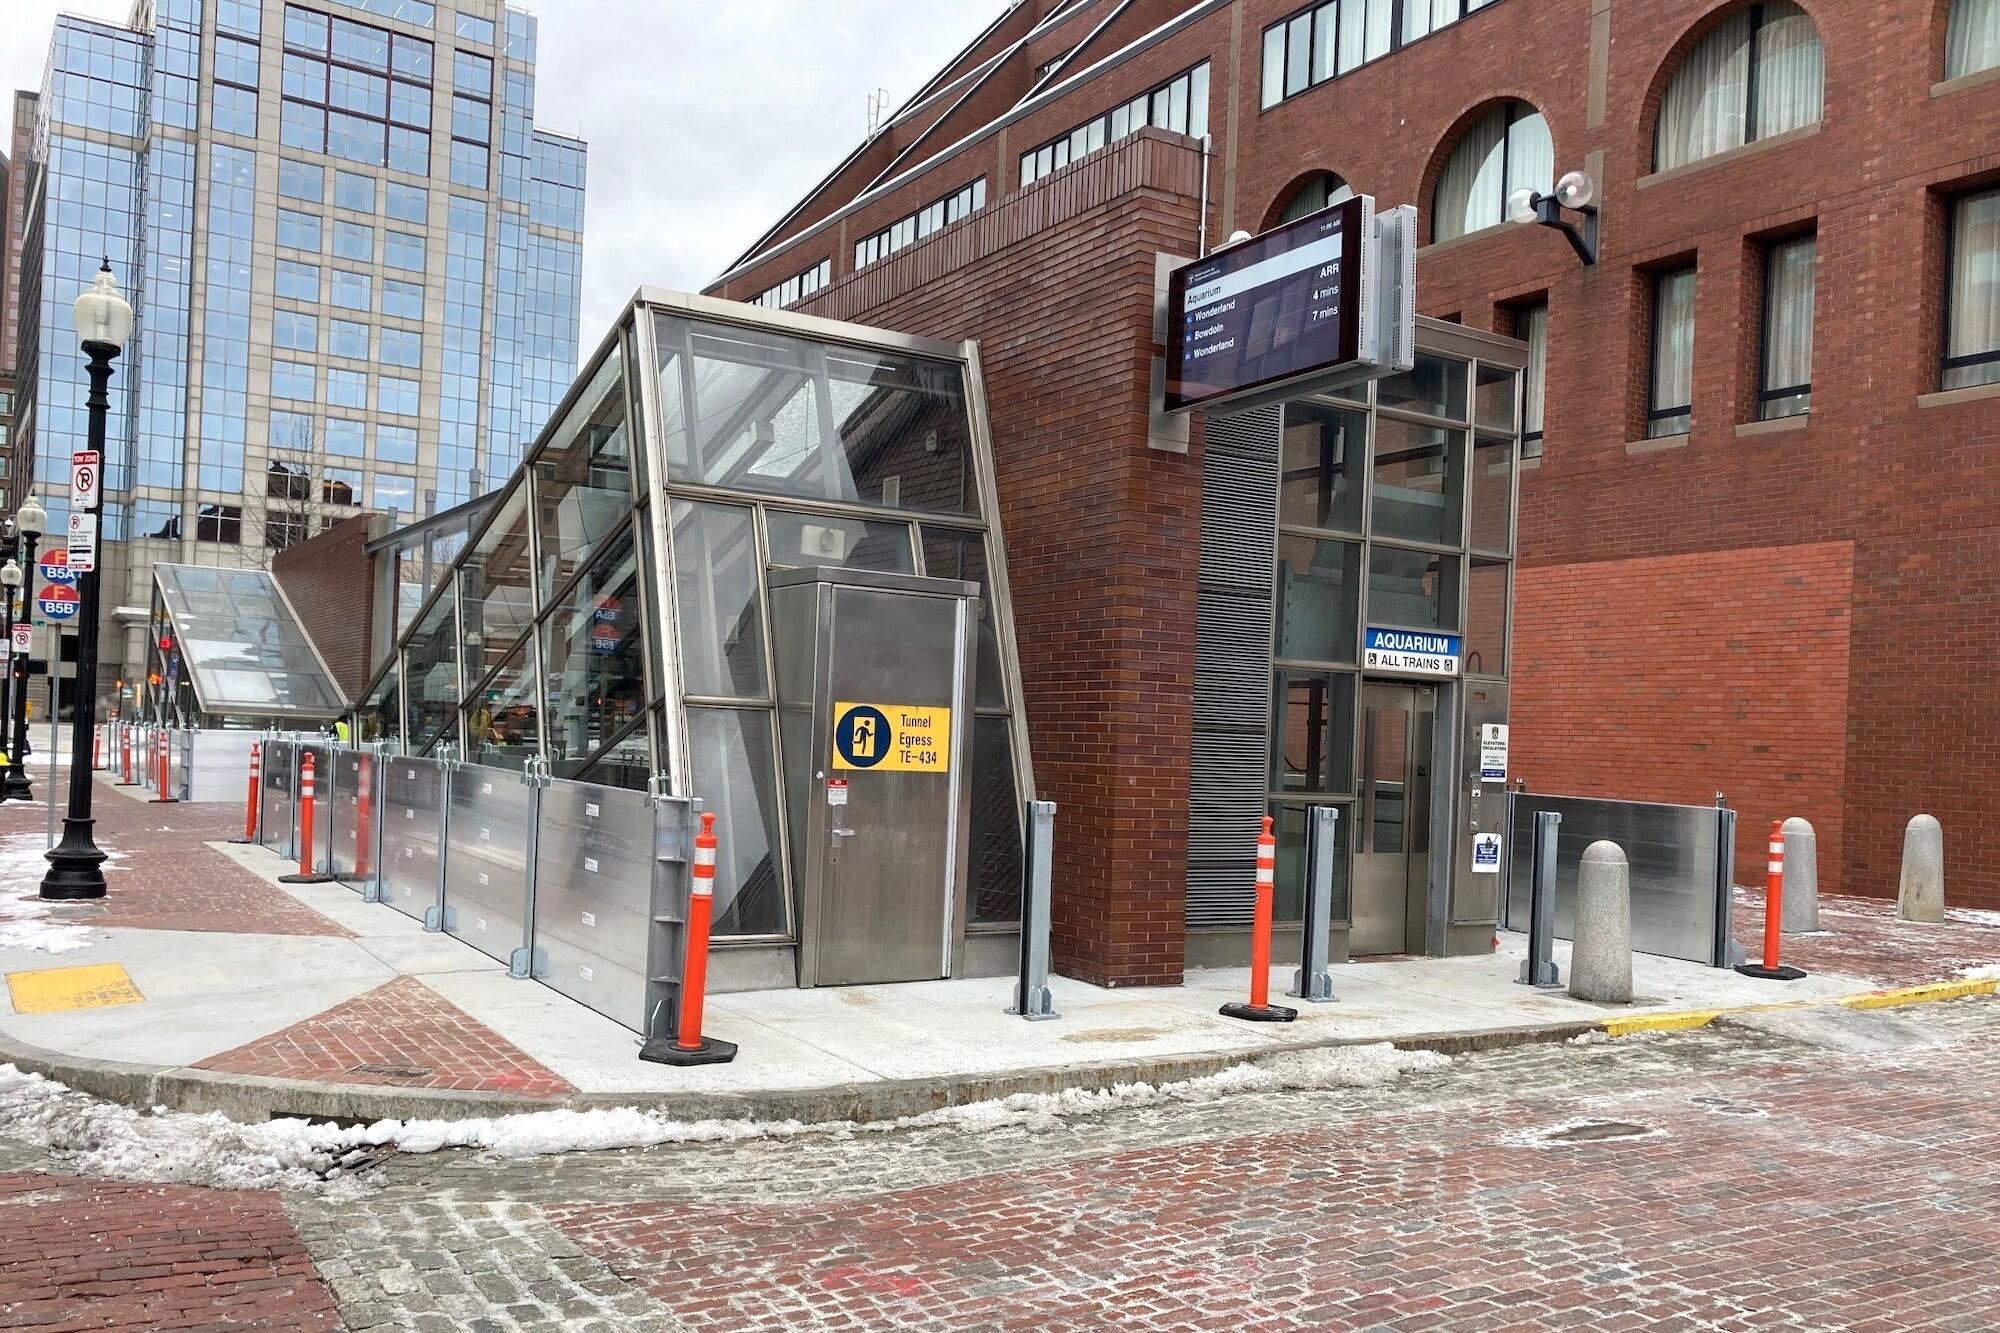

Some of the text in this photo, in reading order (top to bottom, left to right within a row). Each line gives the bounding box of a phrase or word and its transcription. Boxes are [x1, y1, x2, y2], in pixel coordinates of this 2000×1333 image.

[1320, 263, 1339, 279] ARR
[1187, 286, 1221, 305] Aquarium
[1313, 285, 1339, 300] 4 mins
[1195, 300, 1236, 322] Wonderland
[1312, 306, 1339, 321] 7 mins
[1194, 323, 1224, 341] Bowdoin
[1193, 337, 1235, 359] Wonderland
[54, 550, 67, 565] F
[46, 567, 76, 580] B5A
[53, 585, 67, 600] F
[45, 602, 74, 614] B5B
[1375, 632, 1449, 653] AQUARIUM
[1381, 654, 1441, 670] ALL TRAINS
[901, 713, 931, 728] Tunnel
[899, 731, 932, 748] Egress
[899, 750, 937, 764] TE-434
